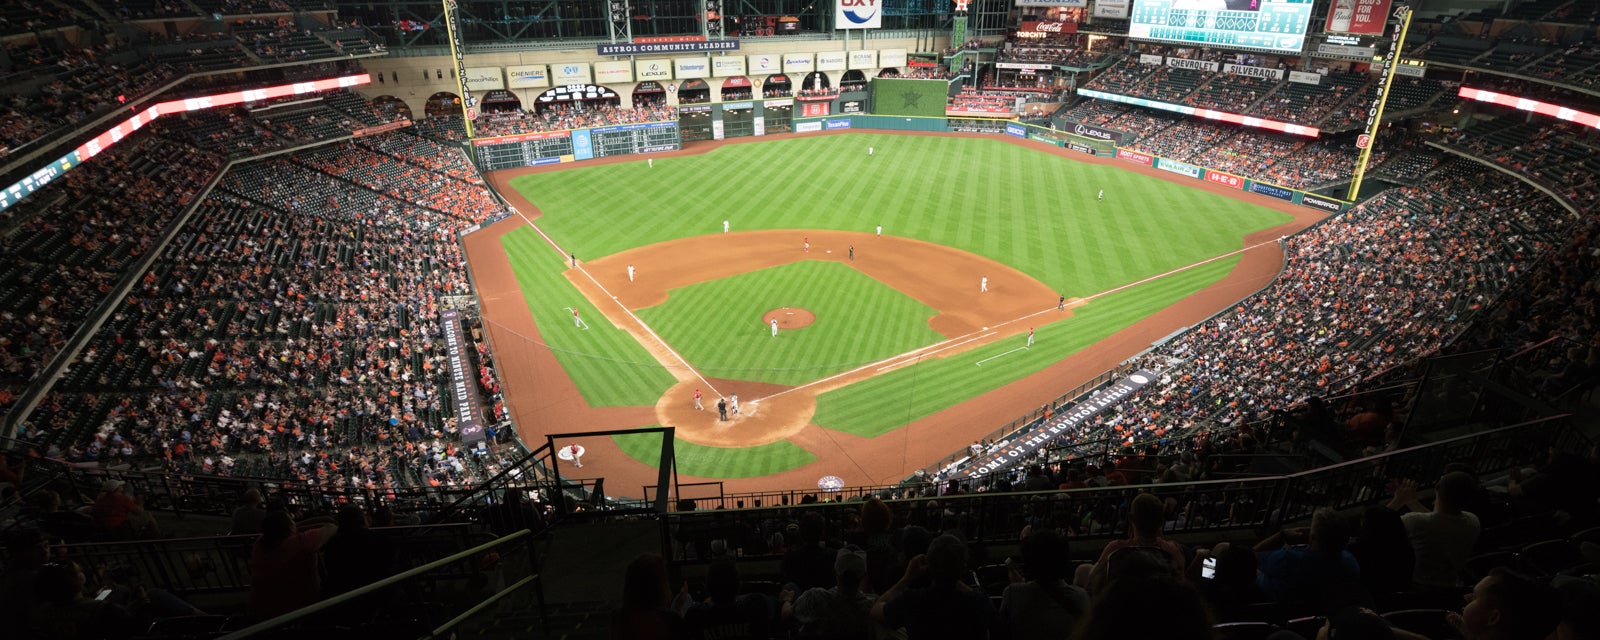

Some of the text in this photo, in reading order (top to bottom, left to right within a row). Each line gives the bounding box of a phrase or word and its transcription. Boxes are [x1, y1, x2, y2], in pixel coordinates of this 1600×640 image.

[1357, 5, 1372, 13] FOR
[1355, 14, 1371, 22] YOU.
[1036, 22, 1063, 33] Coca-Cola
[603, 41, 736, 53] ASTROS COMMUNITY LEADERS
[1378, 24, 1401, 85] BURGERZ
[1170, 58, 1214, 71] CHEVROLET
[1230, 65, 1277, 78] SILVERADO
[1376, 87, 1384, 97] R
[1364, 99, 1380, 134] FOUL
[1007, 126, 1024, 135] GEICO
[1085, 128, 1111, 139] LEXUS
[1120, 150, 1133, 158] ROOT
[1303, 196, 1340, 210] POWERADE
[445, 319, 472, 422] WELCOME TO MINUTE MAID PARK
[1008, 445, 1026, 457] OF
[1026, 433, 1051, 448] THE
[1051, 406, 1098, 434] HOUSTON
[1097, 385, 1133, 408] ASTROS
